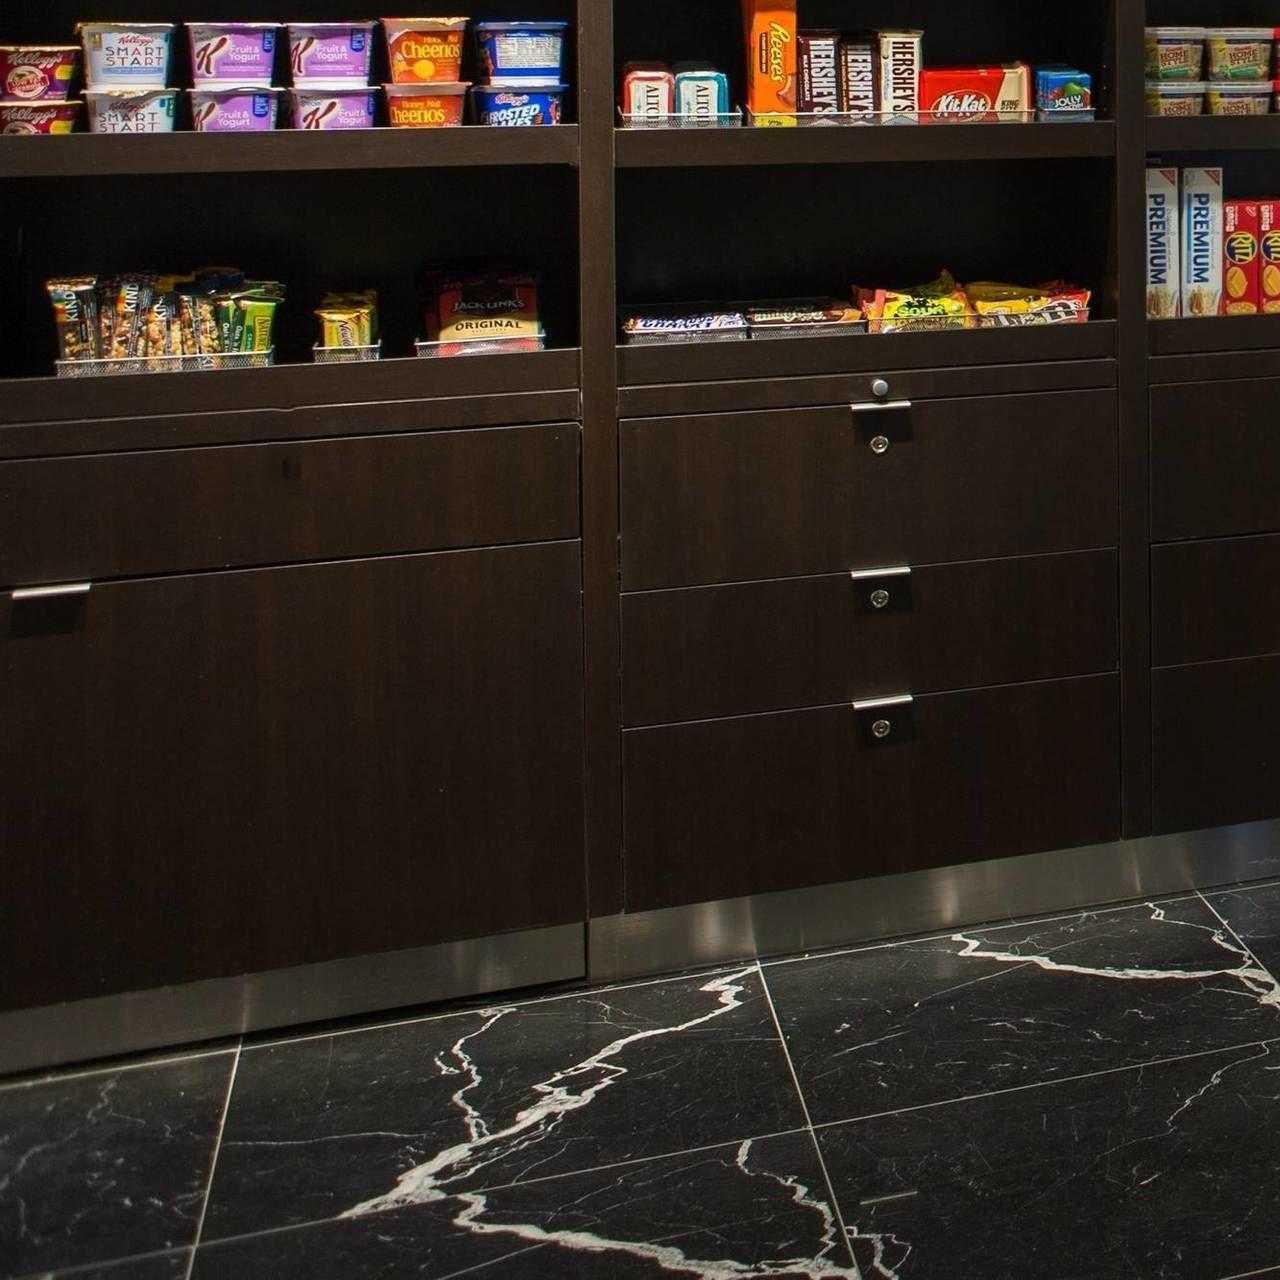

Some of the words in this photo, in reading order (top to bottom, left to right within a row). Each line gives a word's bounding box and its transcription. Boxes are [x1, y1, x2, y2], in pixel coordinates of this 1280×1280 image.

[105, 46, 164, 57] SMART
[196, 36, 229, 75] K
[230, 45, 252, 54] Fruit
[290, 36, 314, 74] K
[317, 44, 339, 53] Fruit
[401, 40, 461, 59] Cheerios
[769, 22, 791, 83] Reese's
[8, 51, 62, 69] Kellogg's
[105, 56, 164, 67] START
[229, 53, 260, 63] Yogurt
[316, 52, 349, 62] Yogurt
[810, 40, 838, 118] HERSHEY'S
[847, 45, 873, 119] HERSHEY'S
[892, 40, 915, 112] HERSHEY'S
[1000, 99, 1019, 107] KING
[1054, 94, 1083, 108] JOLLY
[2, 108, 57, 124] Kellogg's
[99, 112, 158, 123] SMART
[217, 110, 240, 120] Fruit
[303, 101, 338, 130] K
[337, 116, 367, 125] Yogurt
[338, 109, 359, 118] Fruit
[99, 122, 158, 132] START
[217, 119, 250, 129] Yogurt
[1149, 193, 1167, 285] PREMIUM
[1193, 193, 1210, 283] PREMIUM
[1231, 233, 1253, 262] RITZ
[123, 283, 139, 313] KIND
[64, 290, 79, 322] KIND
[455, 320, 523, 332] ORIGINAL
